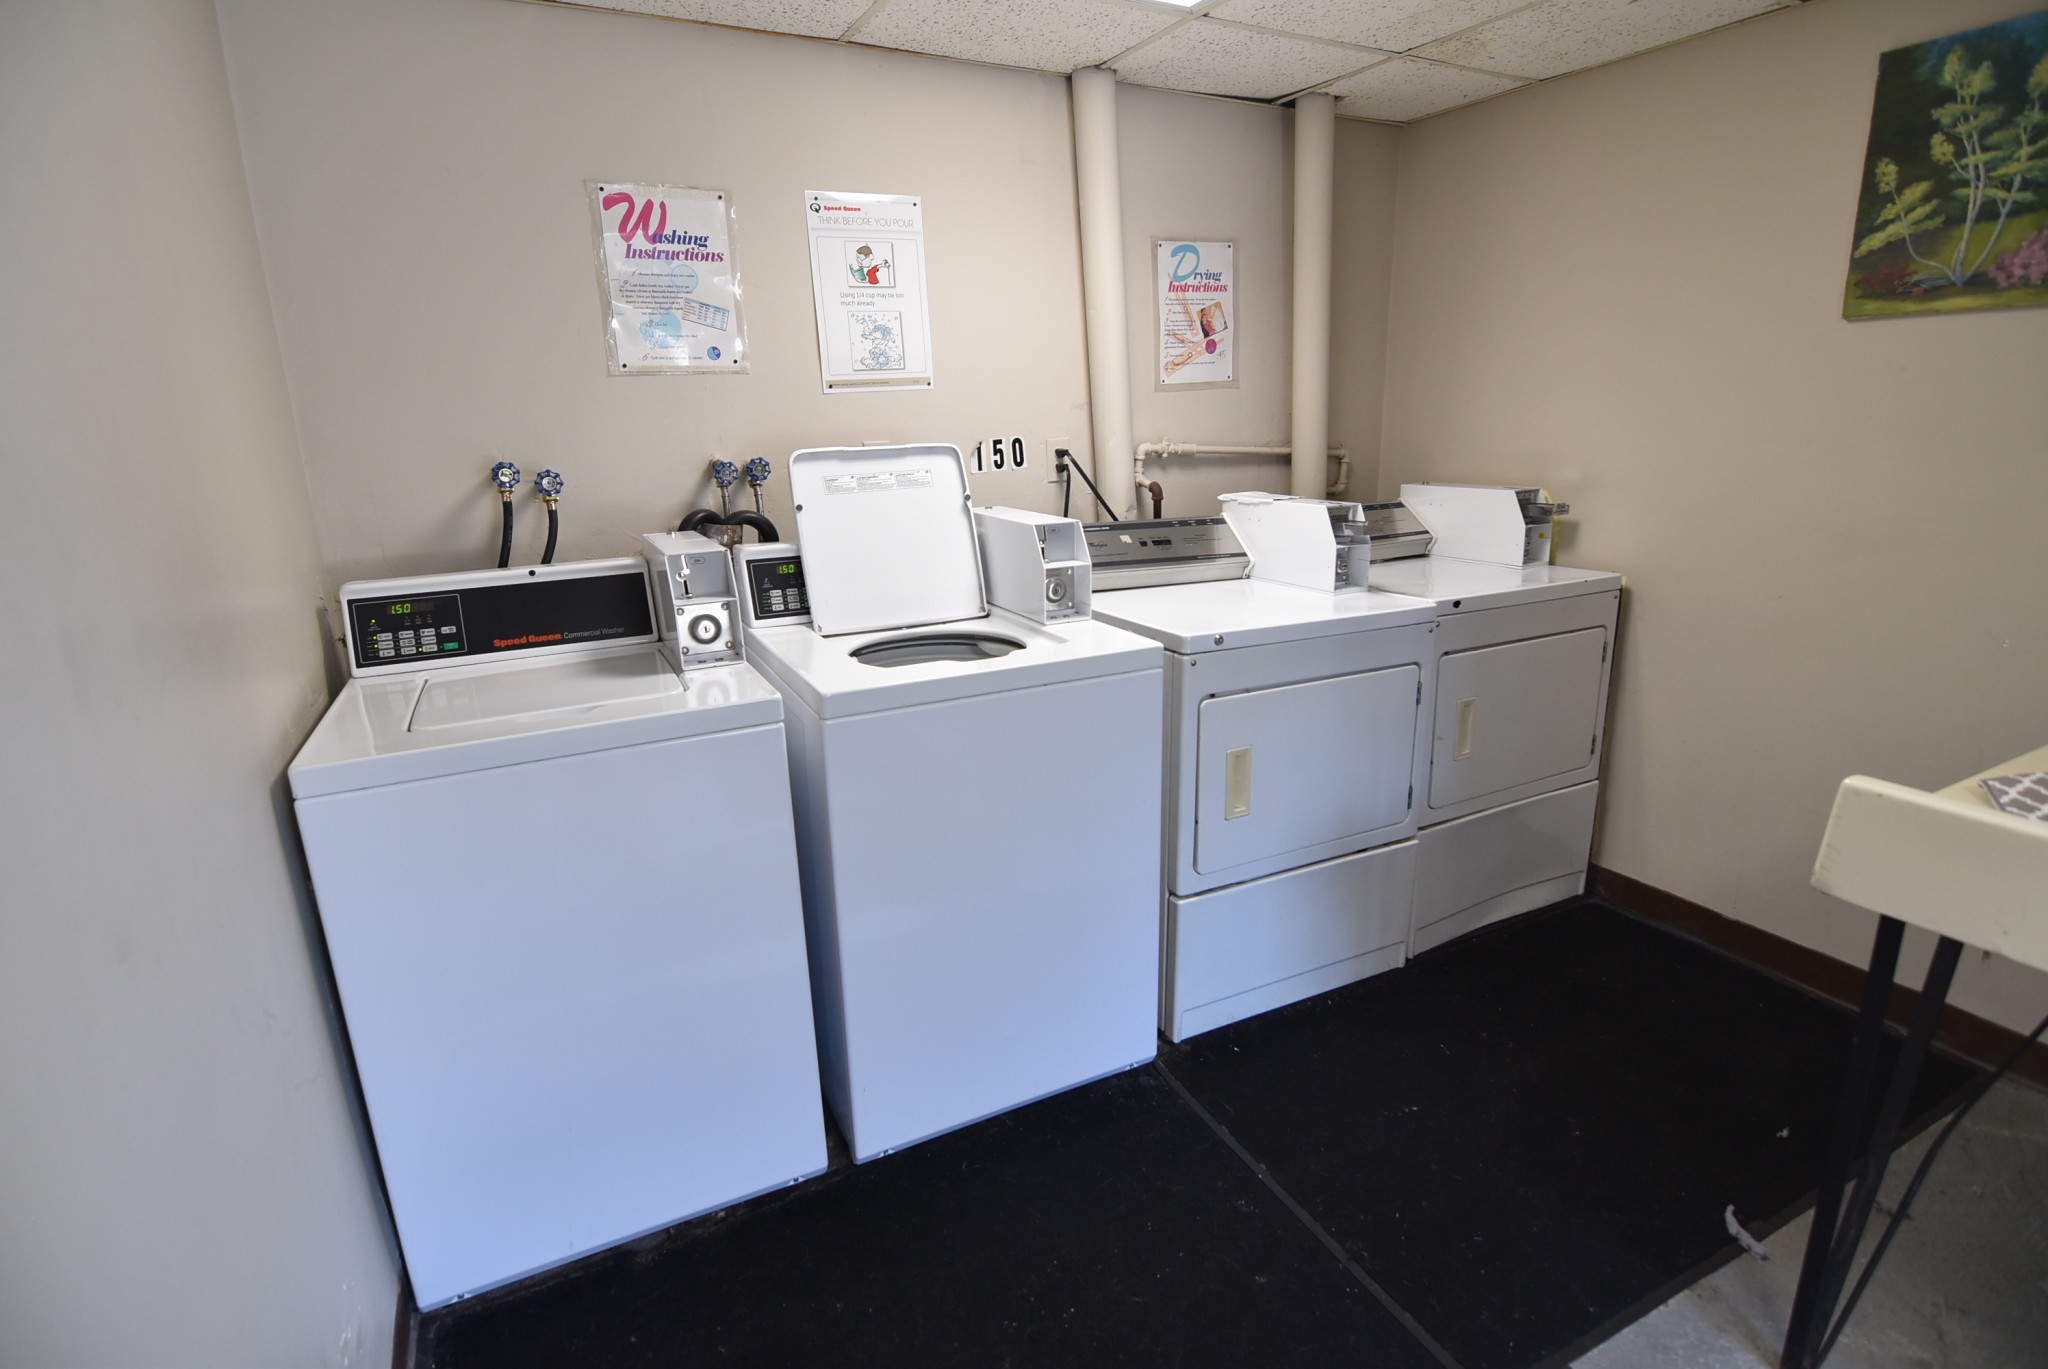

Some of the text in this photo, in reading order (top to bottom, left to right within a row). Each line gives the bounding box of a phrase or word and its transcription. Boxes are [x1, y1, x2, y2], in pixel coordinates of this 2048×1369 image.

[602, 191, 709, 251] Washing
[818, 216, 914, 228] THINK BEFORE YOU POUR
[624, 243, 724, 263] Instructions
[1170, 243, 1222, 284] Drying
[1167, 279, 1228, 293] Instructions
[976, 437, 1025, 471] 150
[493, 626, 625, 648] Speed Queen Commercial Washer
